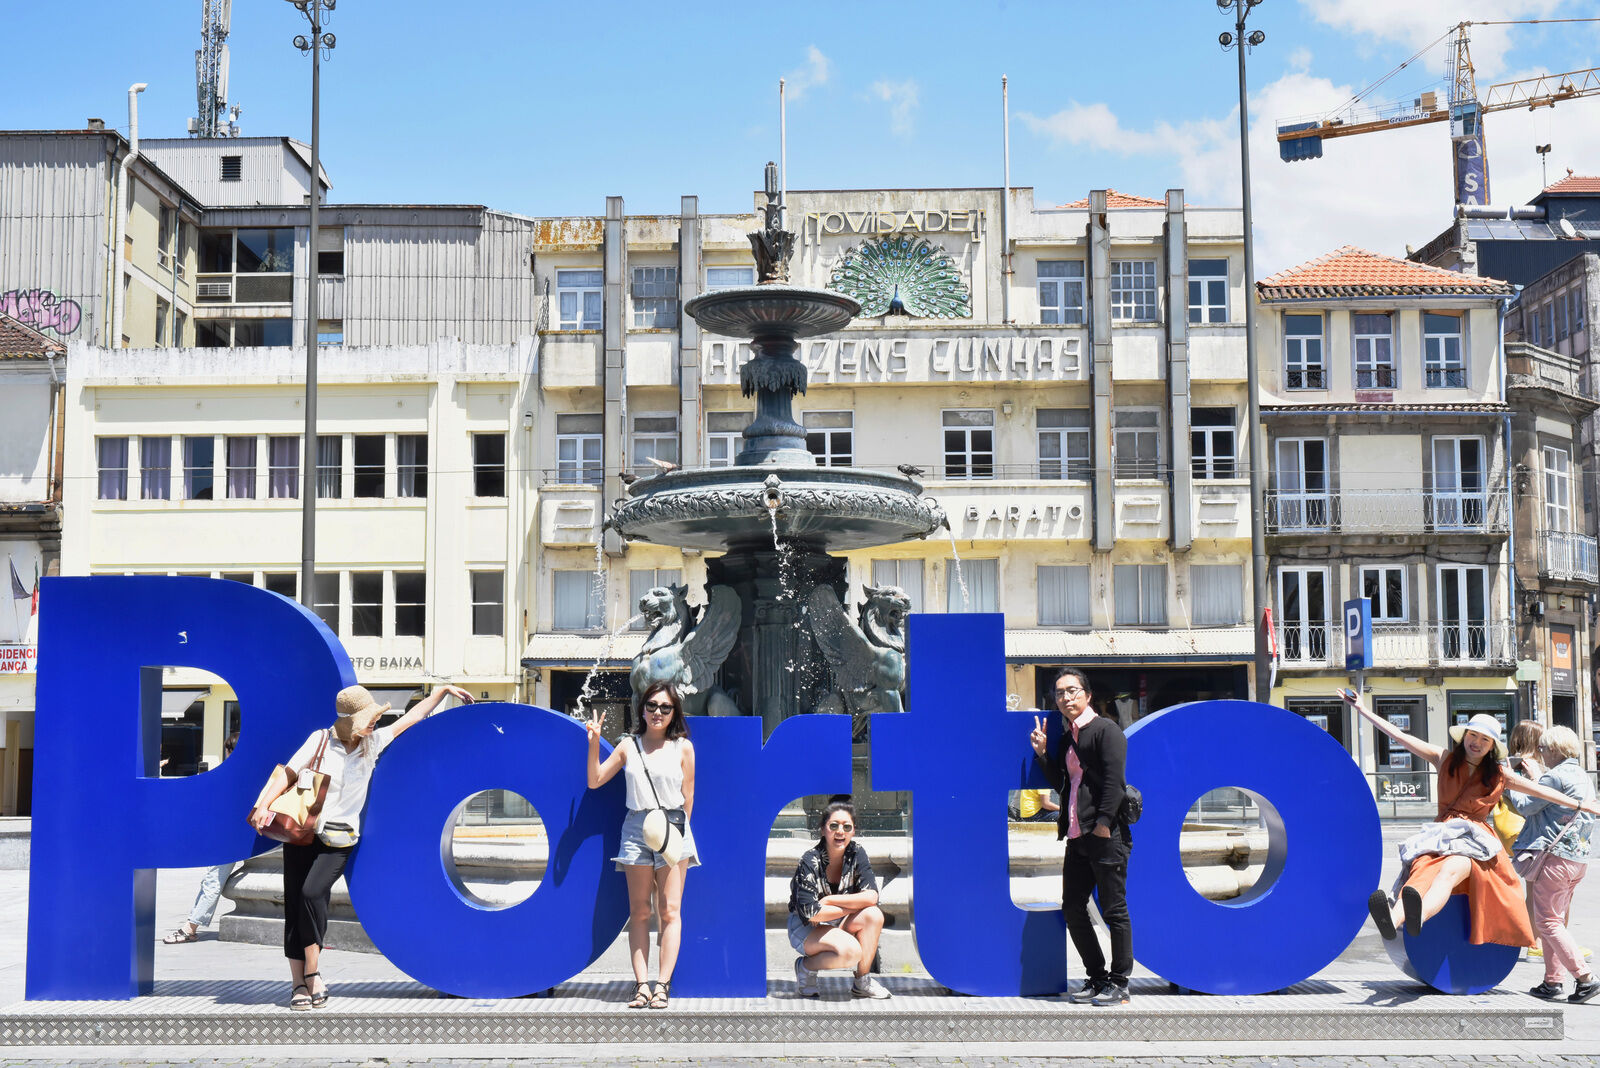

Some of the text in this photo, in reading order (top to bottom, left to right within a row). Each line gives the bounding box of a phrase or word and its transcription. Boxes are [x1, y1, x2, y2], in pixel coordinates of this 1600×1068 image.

[709, 336, 1082, 376] ARZENS CUNHAS
[965, 504, 1084, 521] BARATO
[1346, 607, 1361, 655] P
[379, 656, 423, 669] BAIXA
